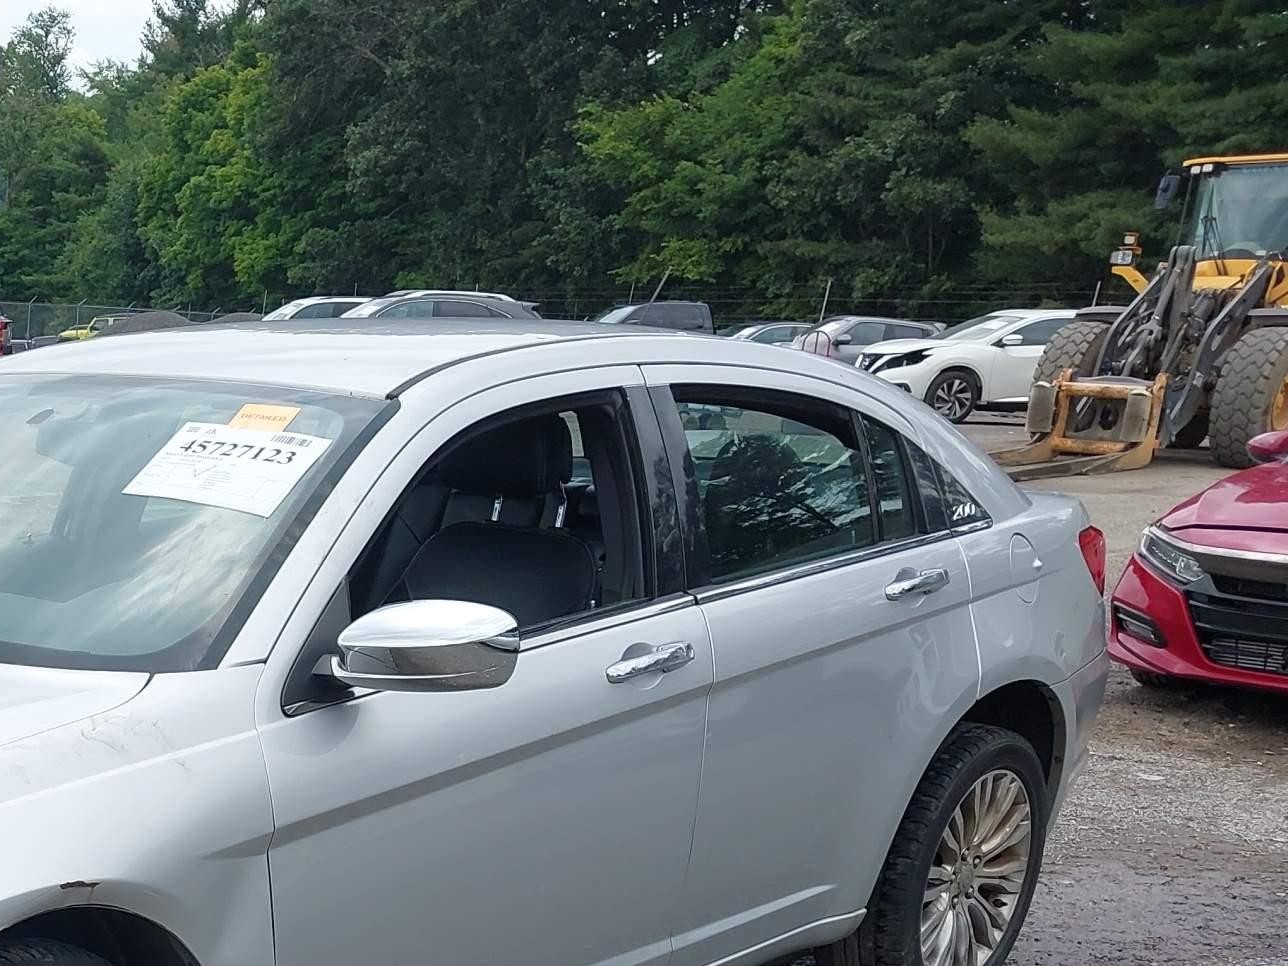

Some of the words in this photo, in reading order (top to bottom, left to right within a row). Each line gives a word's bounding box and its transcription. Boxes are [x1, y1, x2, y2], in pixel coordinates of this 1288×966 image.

[240, 413, 287, 422] DETAILED
[179, 439, 297, 465] 45727123
[952, 502, 976, 520] 200
